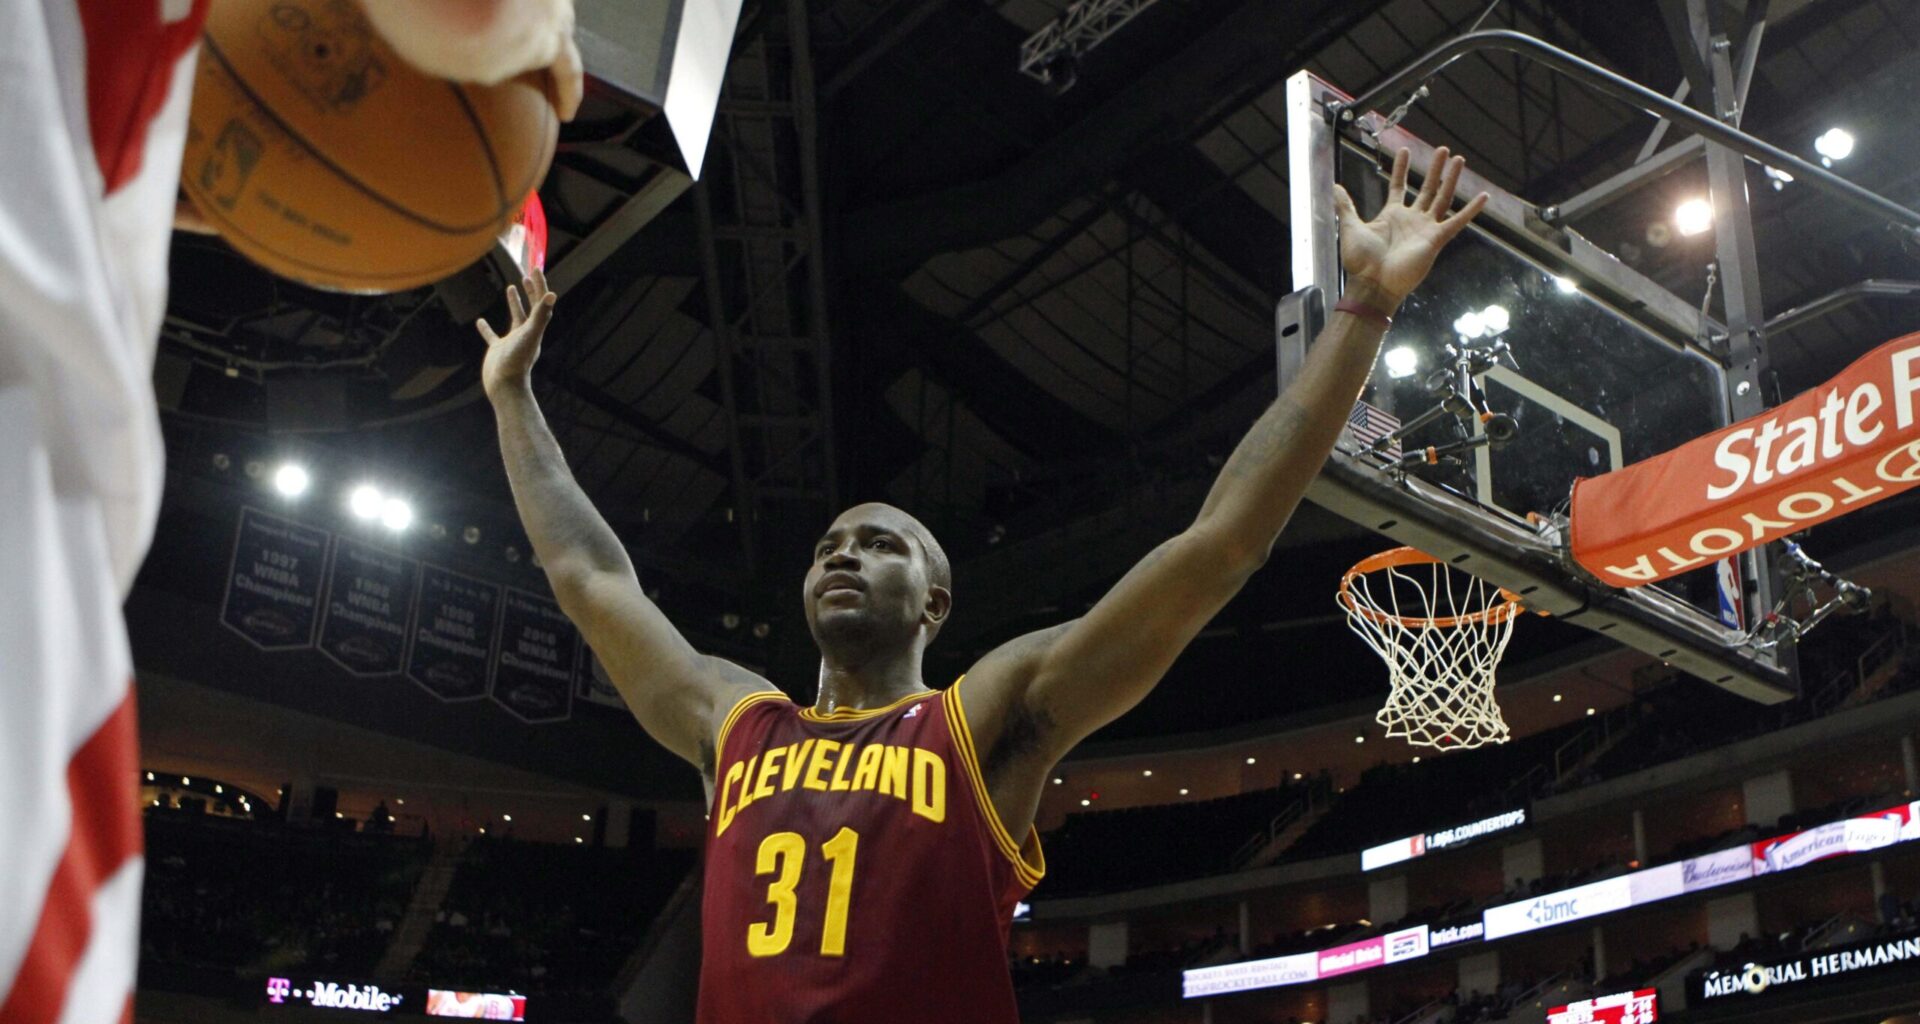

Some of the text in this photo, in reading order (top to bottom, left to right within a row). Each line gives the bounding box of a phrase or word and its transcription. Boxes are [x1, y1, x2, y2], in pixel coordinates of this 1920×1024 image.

[1707, 382, 1884, 500] State
[1605, 477, 1883, 580] TOYOTA
[253, 561, 300, 587] WNBA
[261, 549, 299, 570] 1997
[235, 573, 314, 607] Champions
[347, 589, 391, 615] WNBA
[331, 601, 403, 635] Champions
[434, 616, 476, 640] WNBA
[500, 650, 571, 681] Champions
[517, 639, 558, 662] WNBA
[716, 739, 946, 838] CLEVELAND
[1781, 833, 1845, 867] American
[1683, 862, 1752, 885] Budweiser
[747, 827, 859, 958] 31
[1543, 898, 1578, 923] bmc
[1703, 937, 1920, 998] MEMORIAL HERMANN
